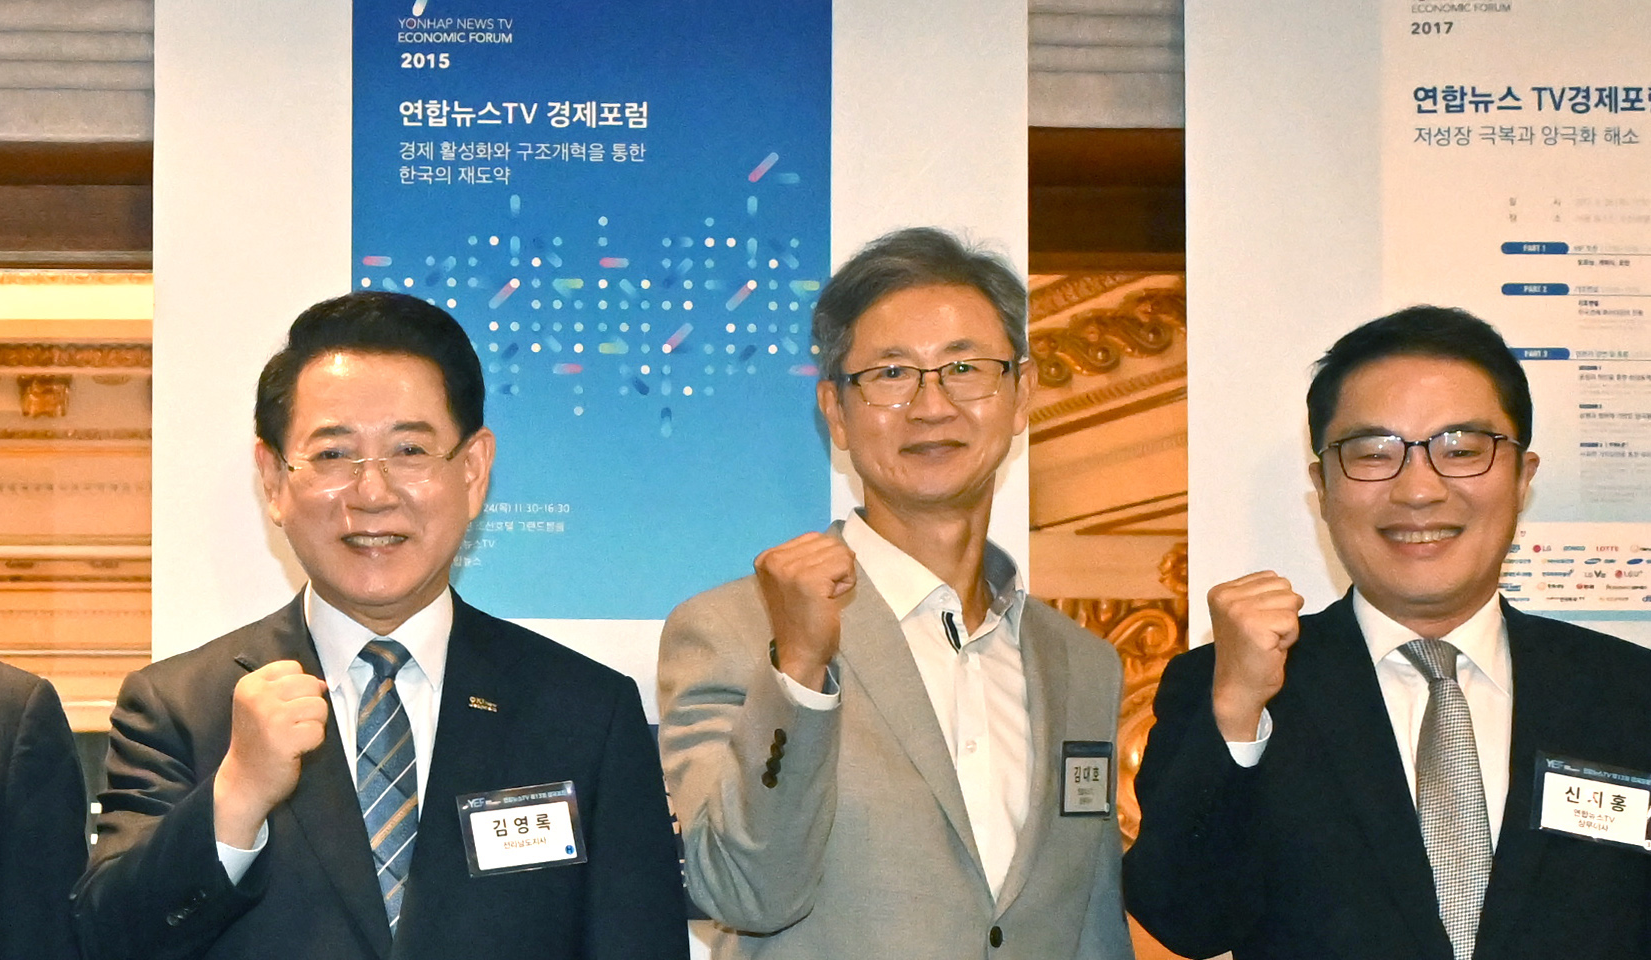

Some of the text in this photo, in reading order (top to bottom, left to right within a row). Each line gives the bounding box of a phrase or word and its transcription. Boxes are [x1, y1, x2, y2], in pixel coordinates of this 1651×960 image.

[1411, 3, 1511, 13] ECONOMIC FORUM
[398, 18, 513, 30] YONHAP NEWS TV
[1411, 21, 1454, 34] 2017
[398, 32, 513, 43] ECONOMIC FORUM
[400, 52, 451, 69] 2015
[1413, 85, 1651, 114] 연합뉴스 TV경제포
[399, 99, 649, 129] 연합뉴스TV 경제포럼
[1413, 126, 1641, 146] 저성장 극복과 양극화 해소
[399, 141, 646, 163] 경제 활성화와 구조개혁을 통한
[399, 165, 511, 186] 한국의 재도약
[1523, 244, 1541, 252] PART
[460, 539, 496, 550] 뉴스TV
